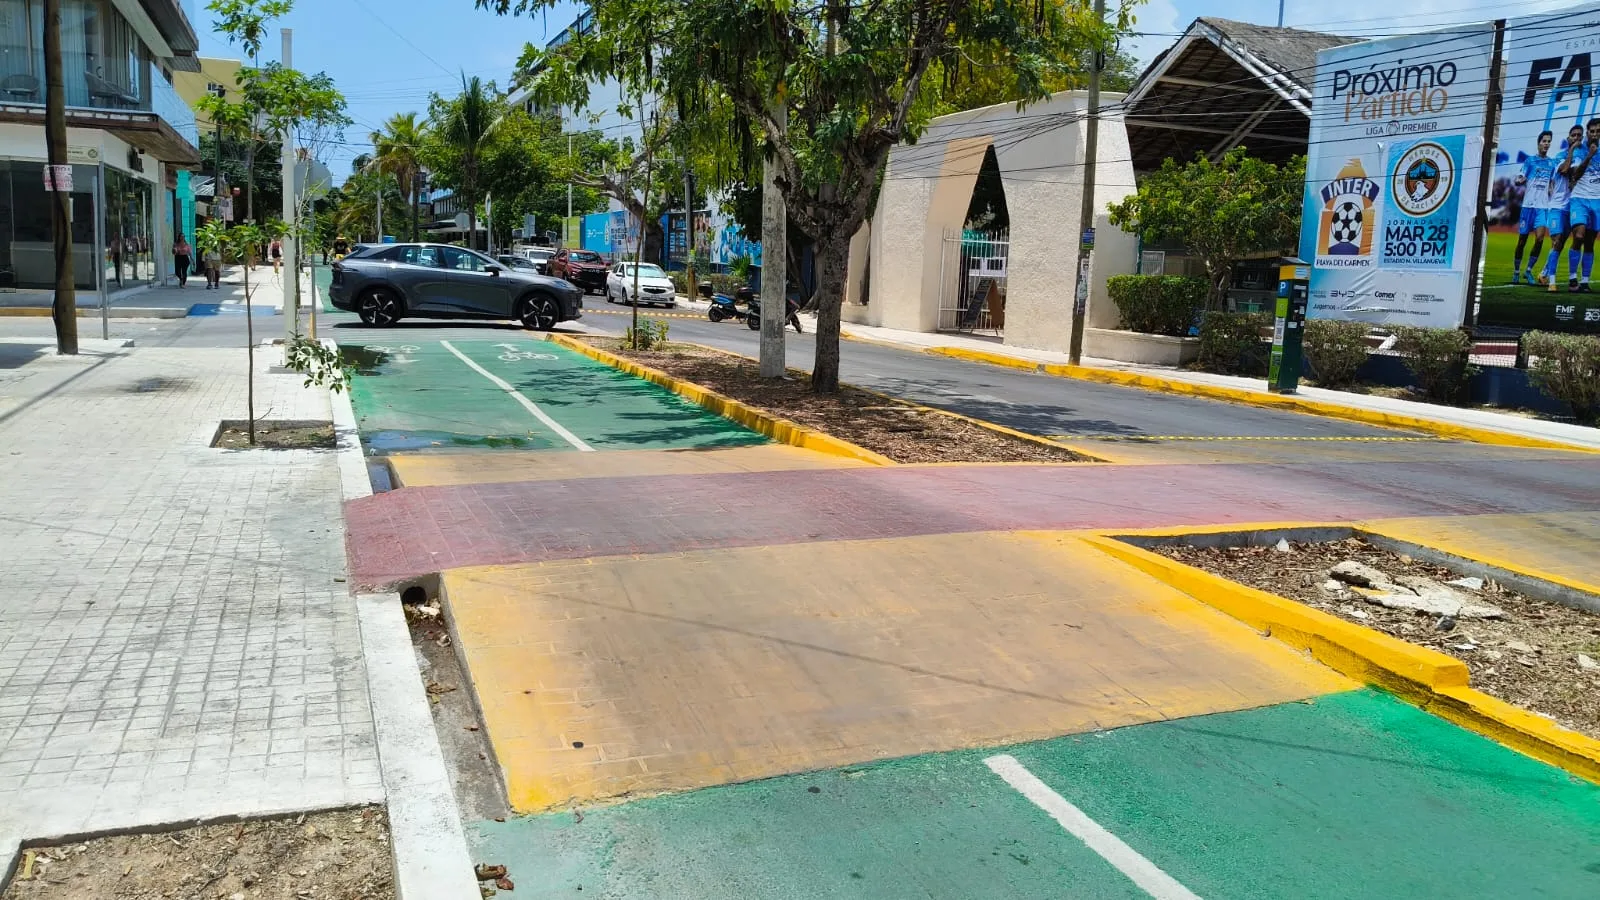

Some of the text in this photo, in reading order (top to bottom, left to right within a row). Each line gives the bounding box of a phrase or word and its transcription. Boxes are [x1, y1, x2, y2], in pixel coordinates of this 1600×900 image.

[1566, 39, 1600, 50] ESTA
[1333, 59, 1457, 100] Próximo
[1345, 83, 1448, 122] Partido
[1365, 121, 1438, 136] LIGA PREMIER
[1327, 178, 1373, 199] INTER
[1385, 225, 1449, 241] MAR 28
[1384, 242, 1447, 257] 5:00 PM
[1316, 258, 1370, 267] PLAYA DEL CARMEN
[1374, 290, 1396, 299] Comex
[1555, 304, 1576, 313] FMF
